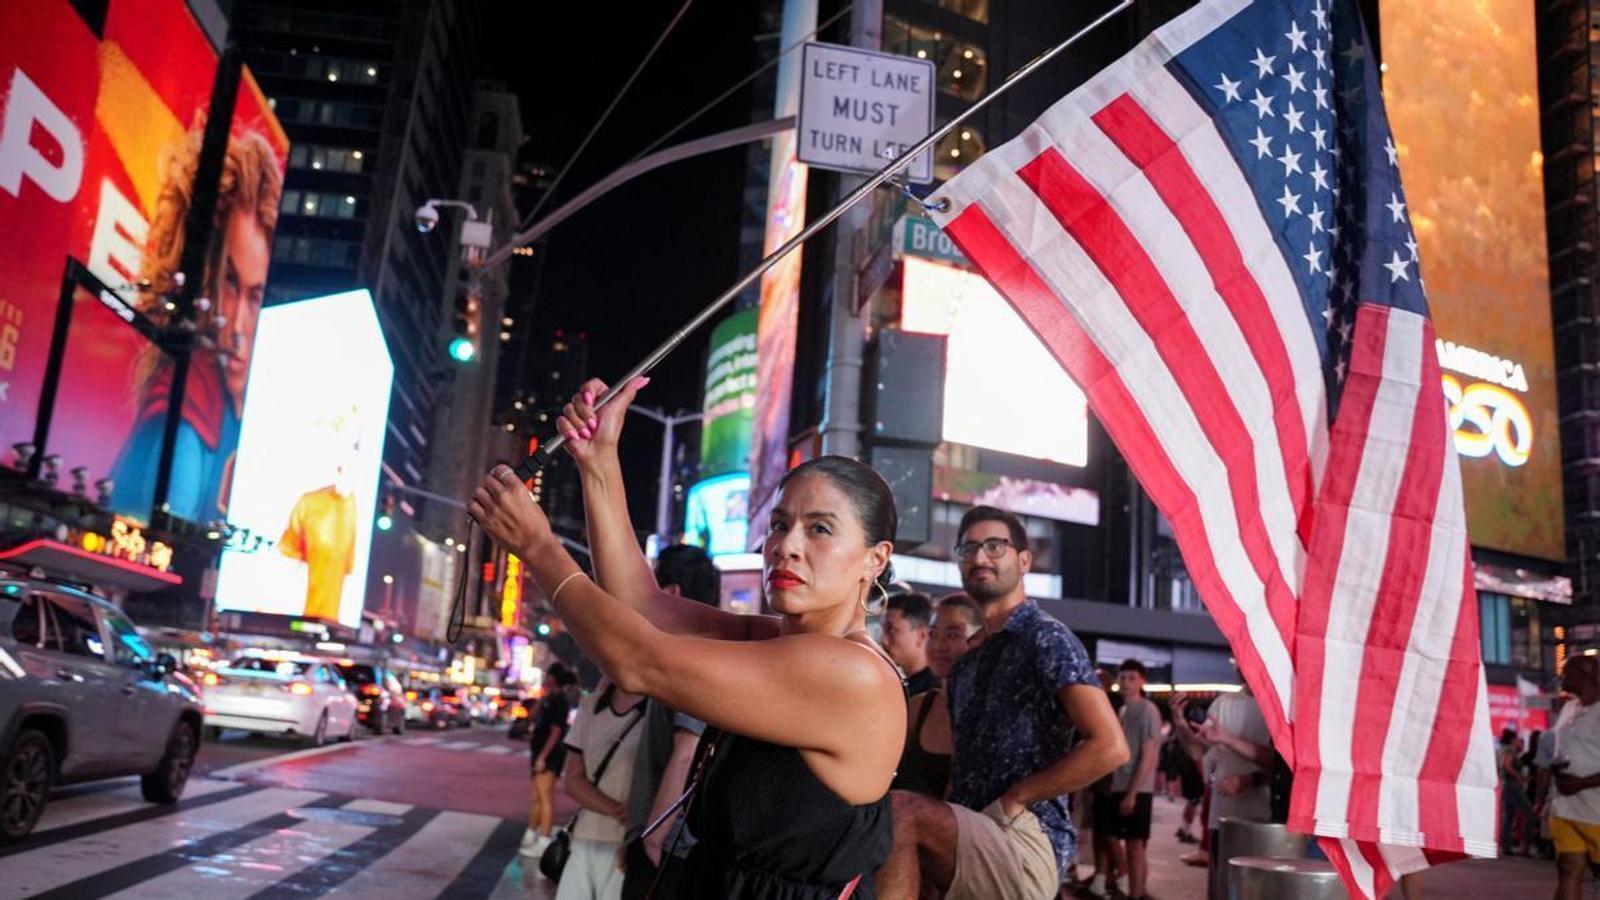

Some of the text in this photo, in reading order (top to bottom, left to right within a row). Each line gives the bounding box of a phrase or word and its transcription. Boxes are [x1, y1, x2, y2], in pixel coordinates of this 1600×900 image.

[813, 59, 921, 94] LEFT LANE
[832, 95, 899, 127] MUST
[810, 129, 916, 162] TURN LEF
